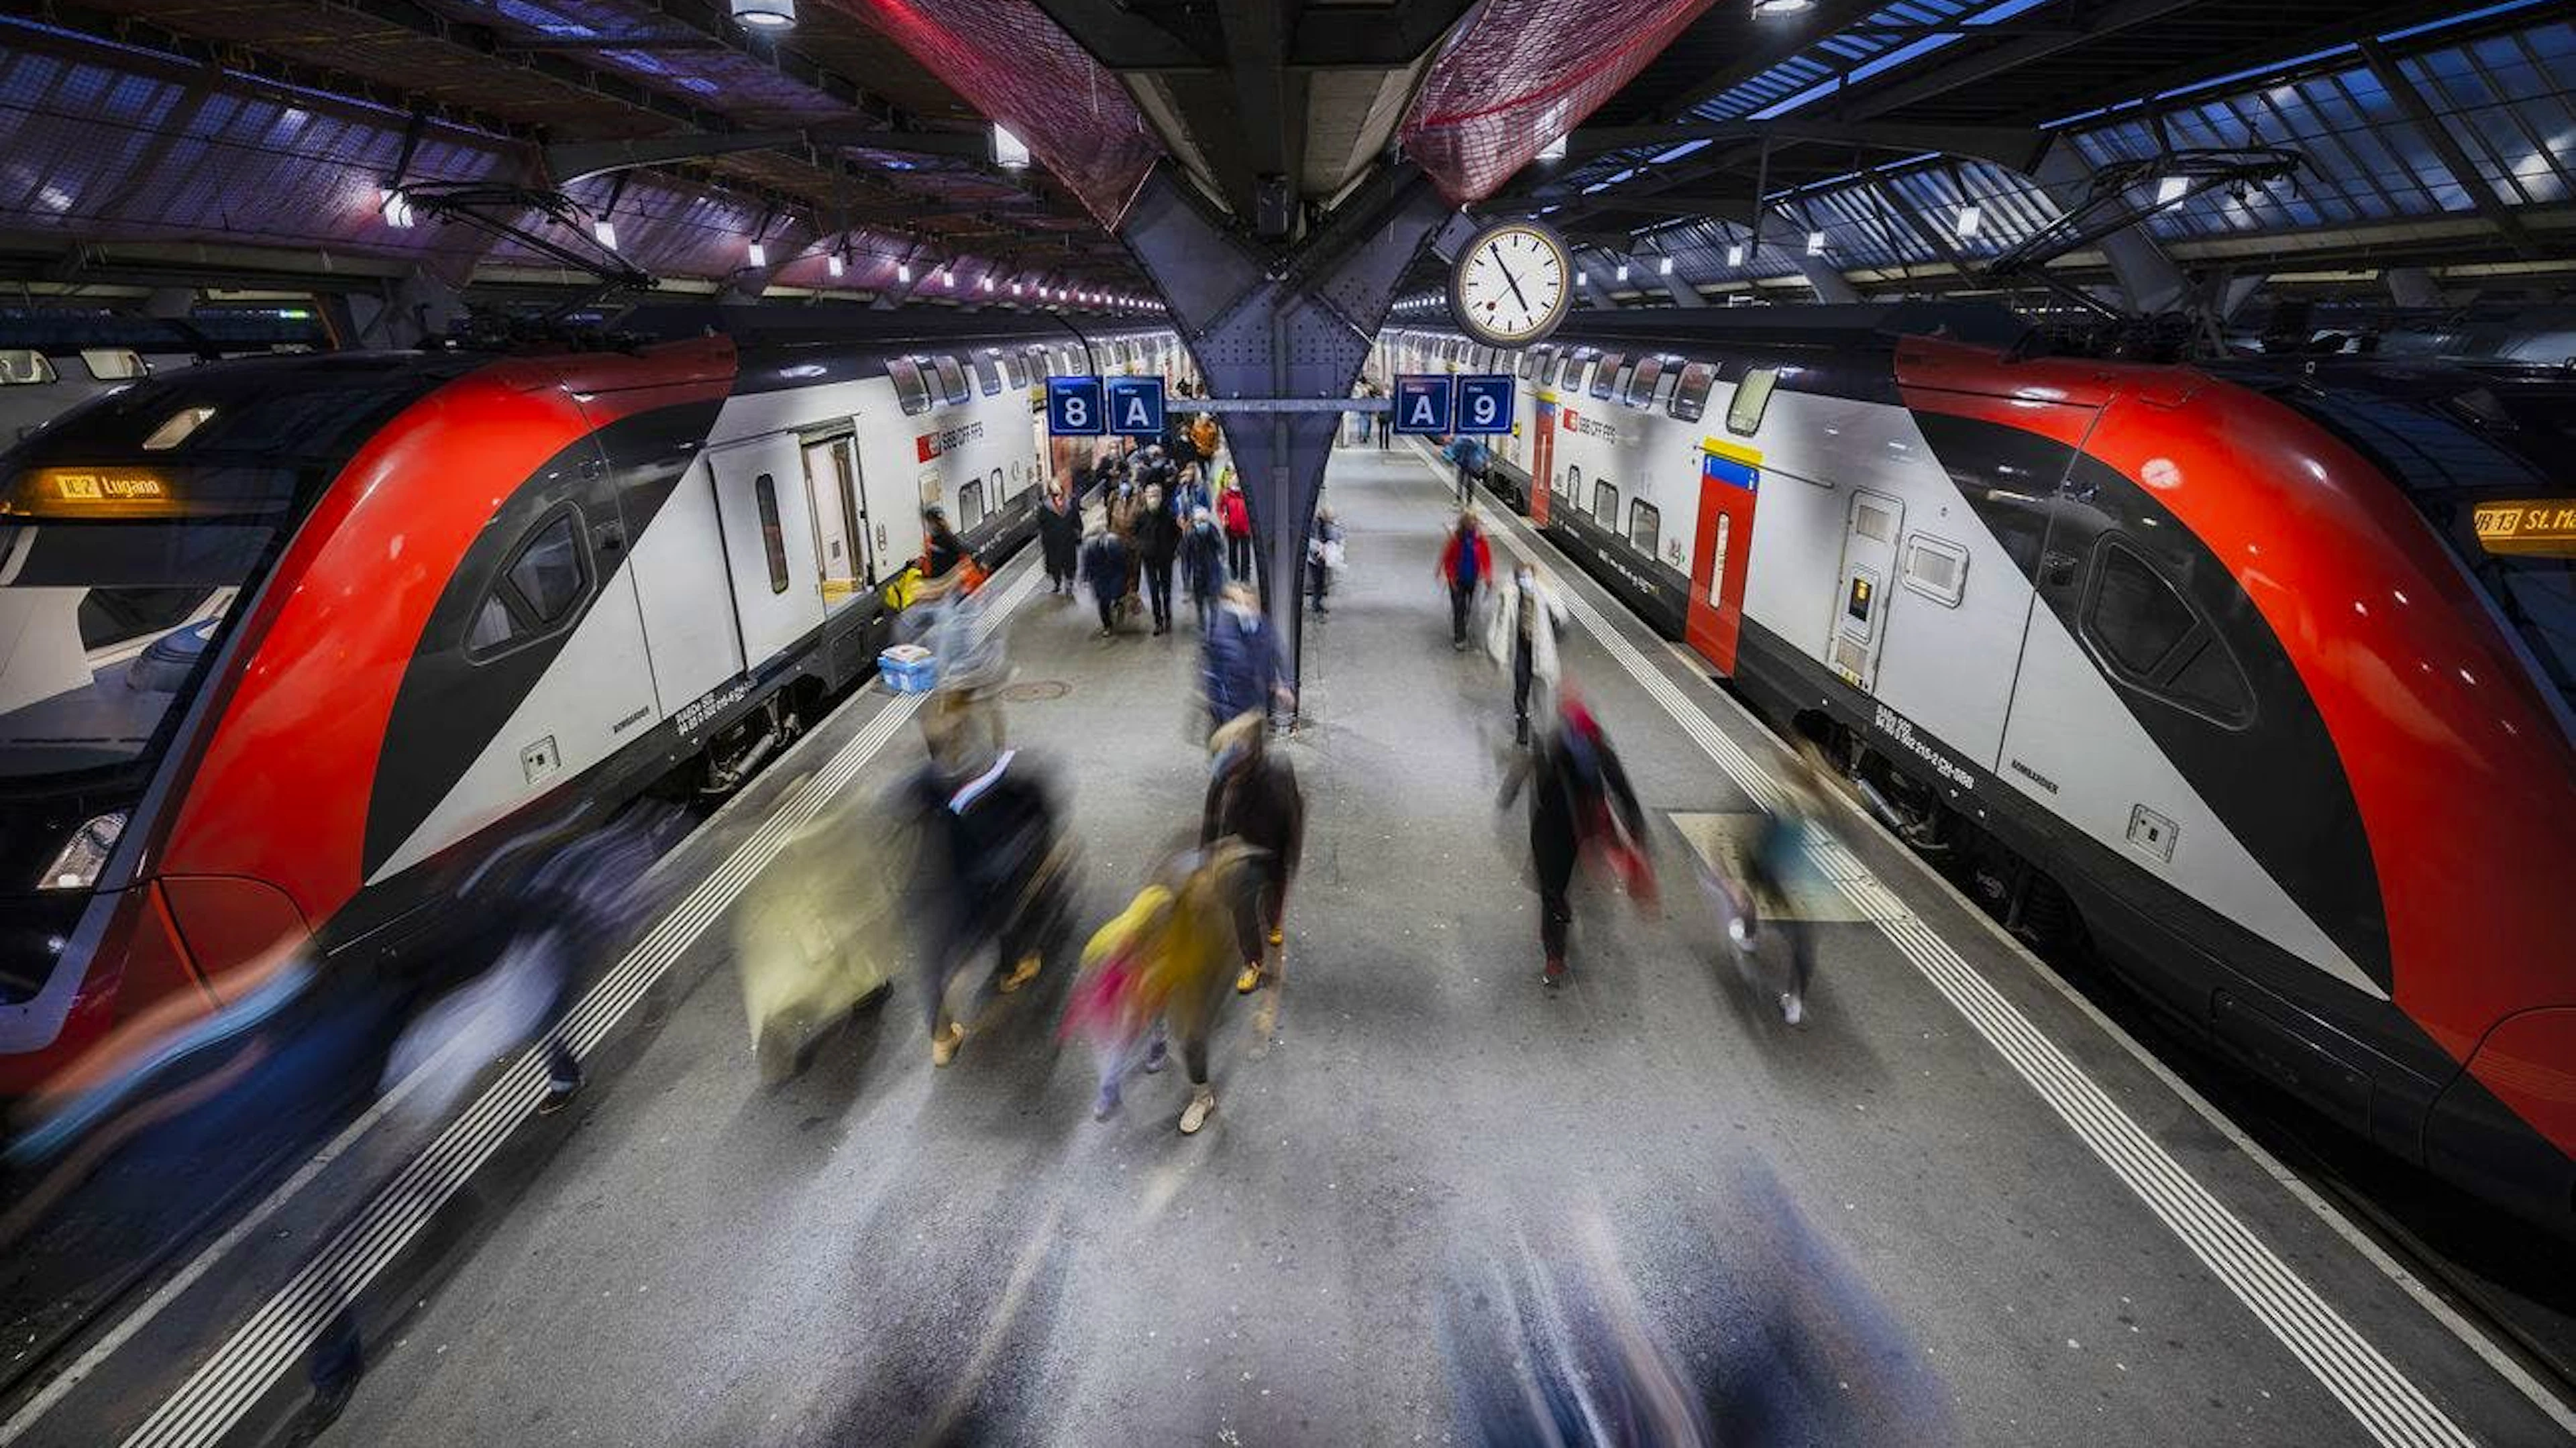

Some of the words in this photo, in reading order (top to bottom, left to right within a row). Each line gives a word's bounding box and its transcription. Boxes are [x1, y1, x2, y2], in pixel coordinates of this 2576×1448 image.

[1065, 396, 1087, 427] 8
[1124, 396, 1150, 427] A
[1409, 394, 1436, 425] A
[1474, 394, 1497, 425] 9
[101, 476, 160, 498] Lugano
[2497, 512, 2518, 531] 13
[2525, 509, 2550, 530] St.
